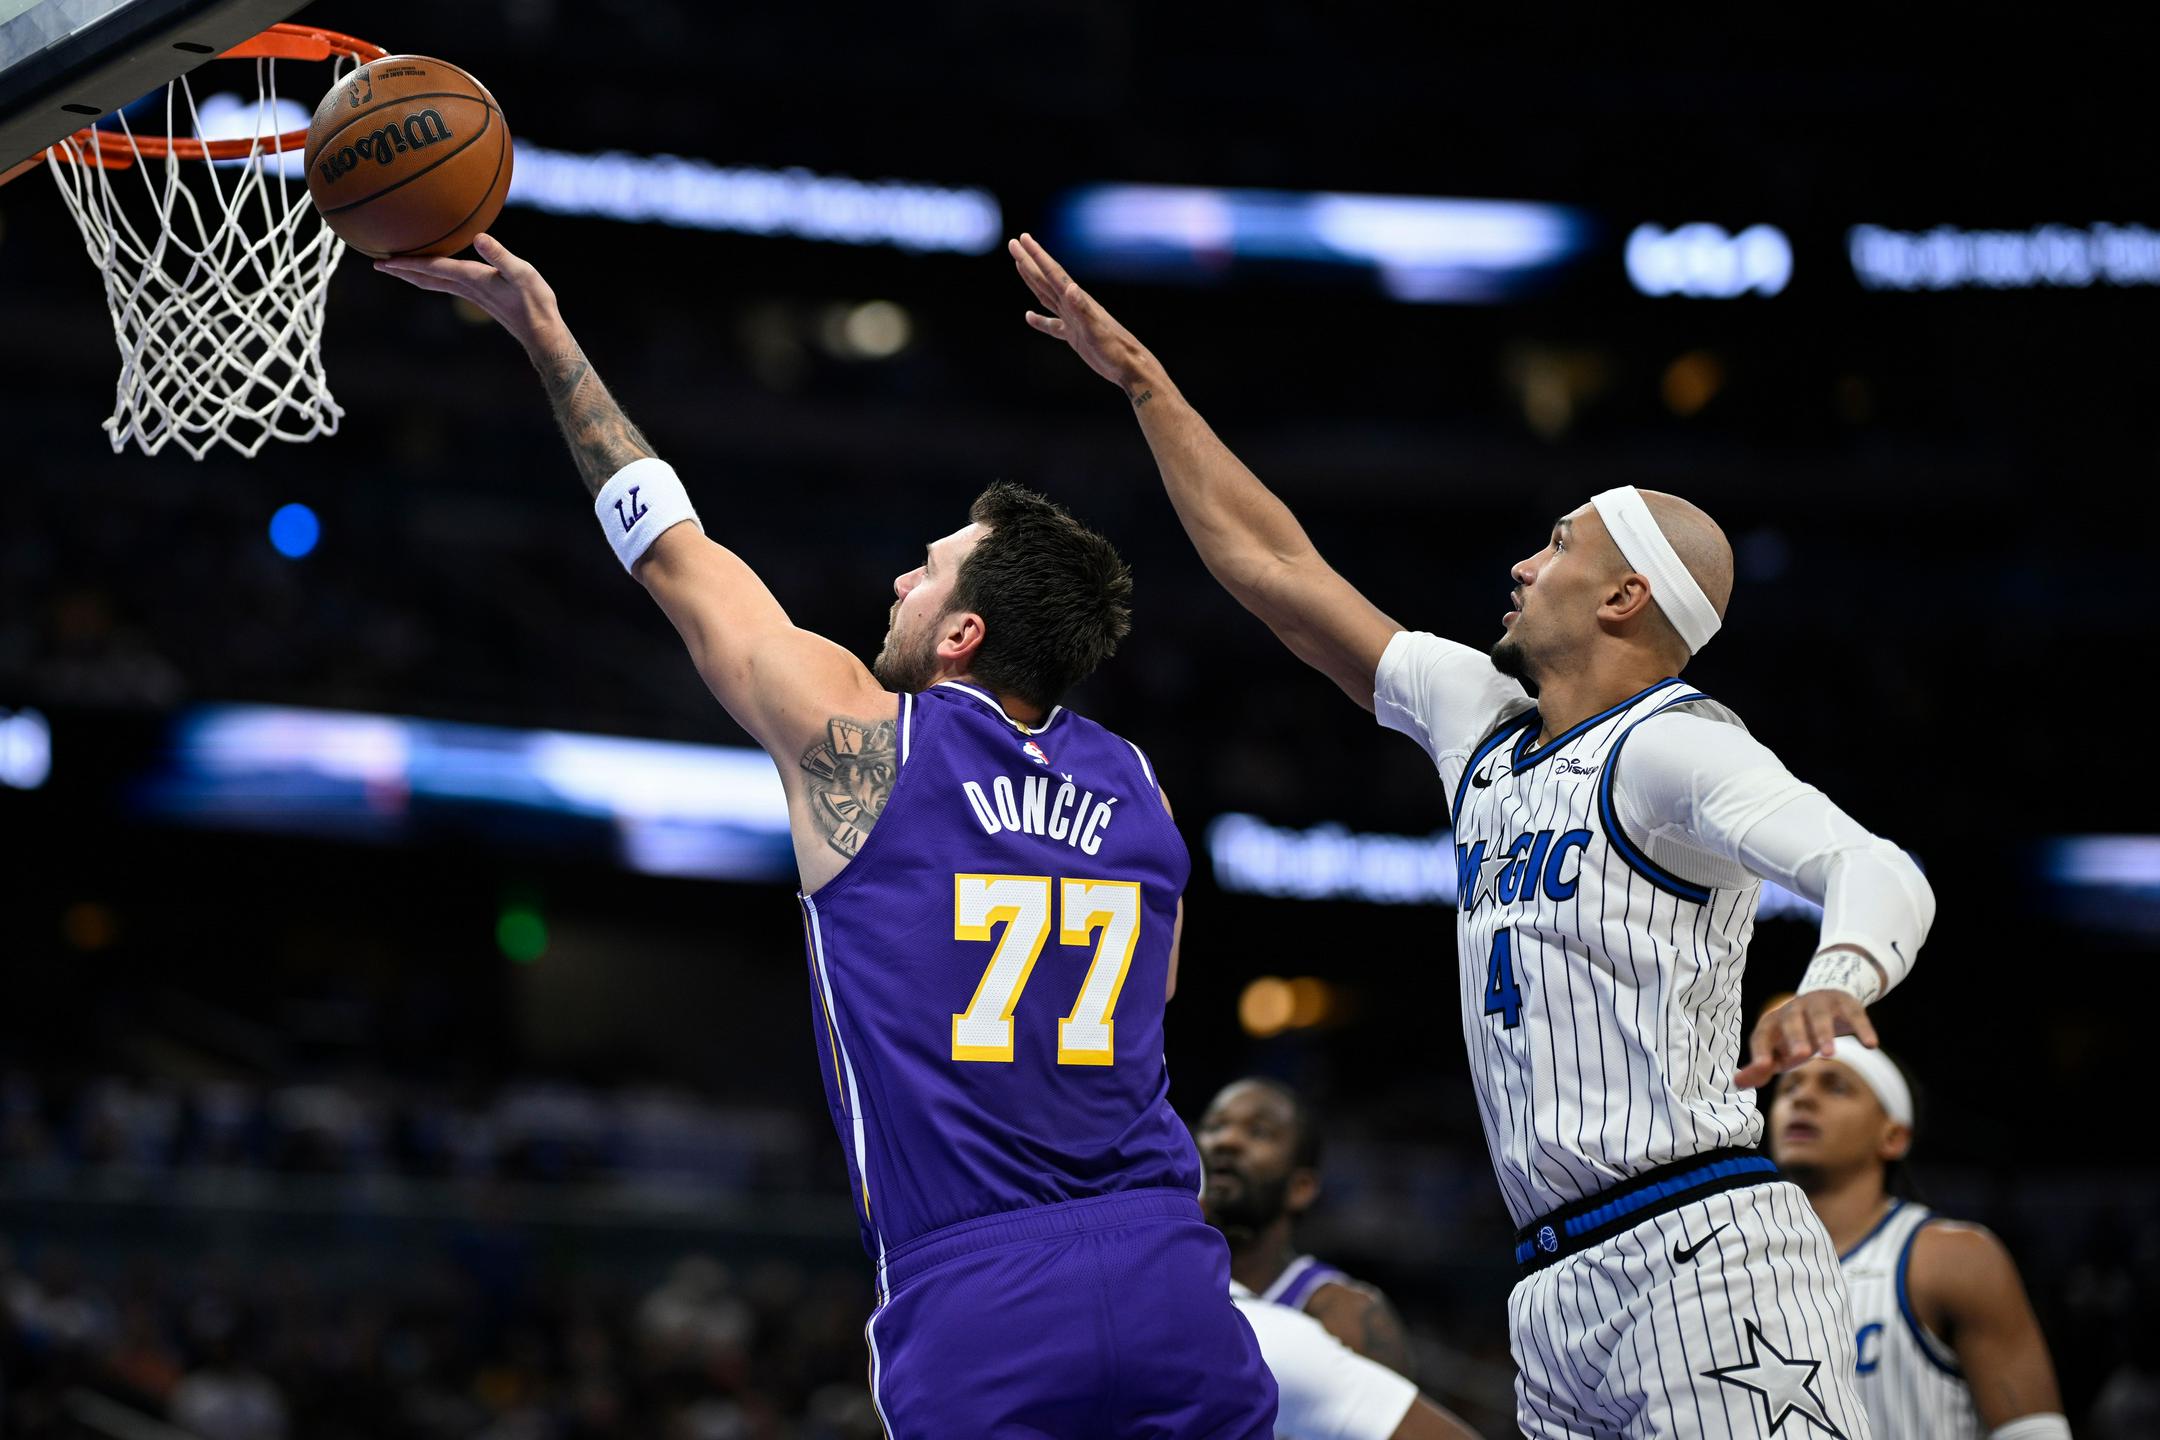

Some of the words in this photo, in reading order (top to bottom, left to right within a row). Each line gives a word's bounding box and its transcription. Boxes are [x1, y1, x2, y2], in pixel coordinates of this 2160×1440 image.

[319, 108, 452, 184] Wilson
[1555, 757, 1599, 780] Disney
[962, 772, 1118, 855] DONČIĆ
[952, 873, 1141, 1066] 77
[1484, 926, 1523, 1031] 4
